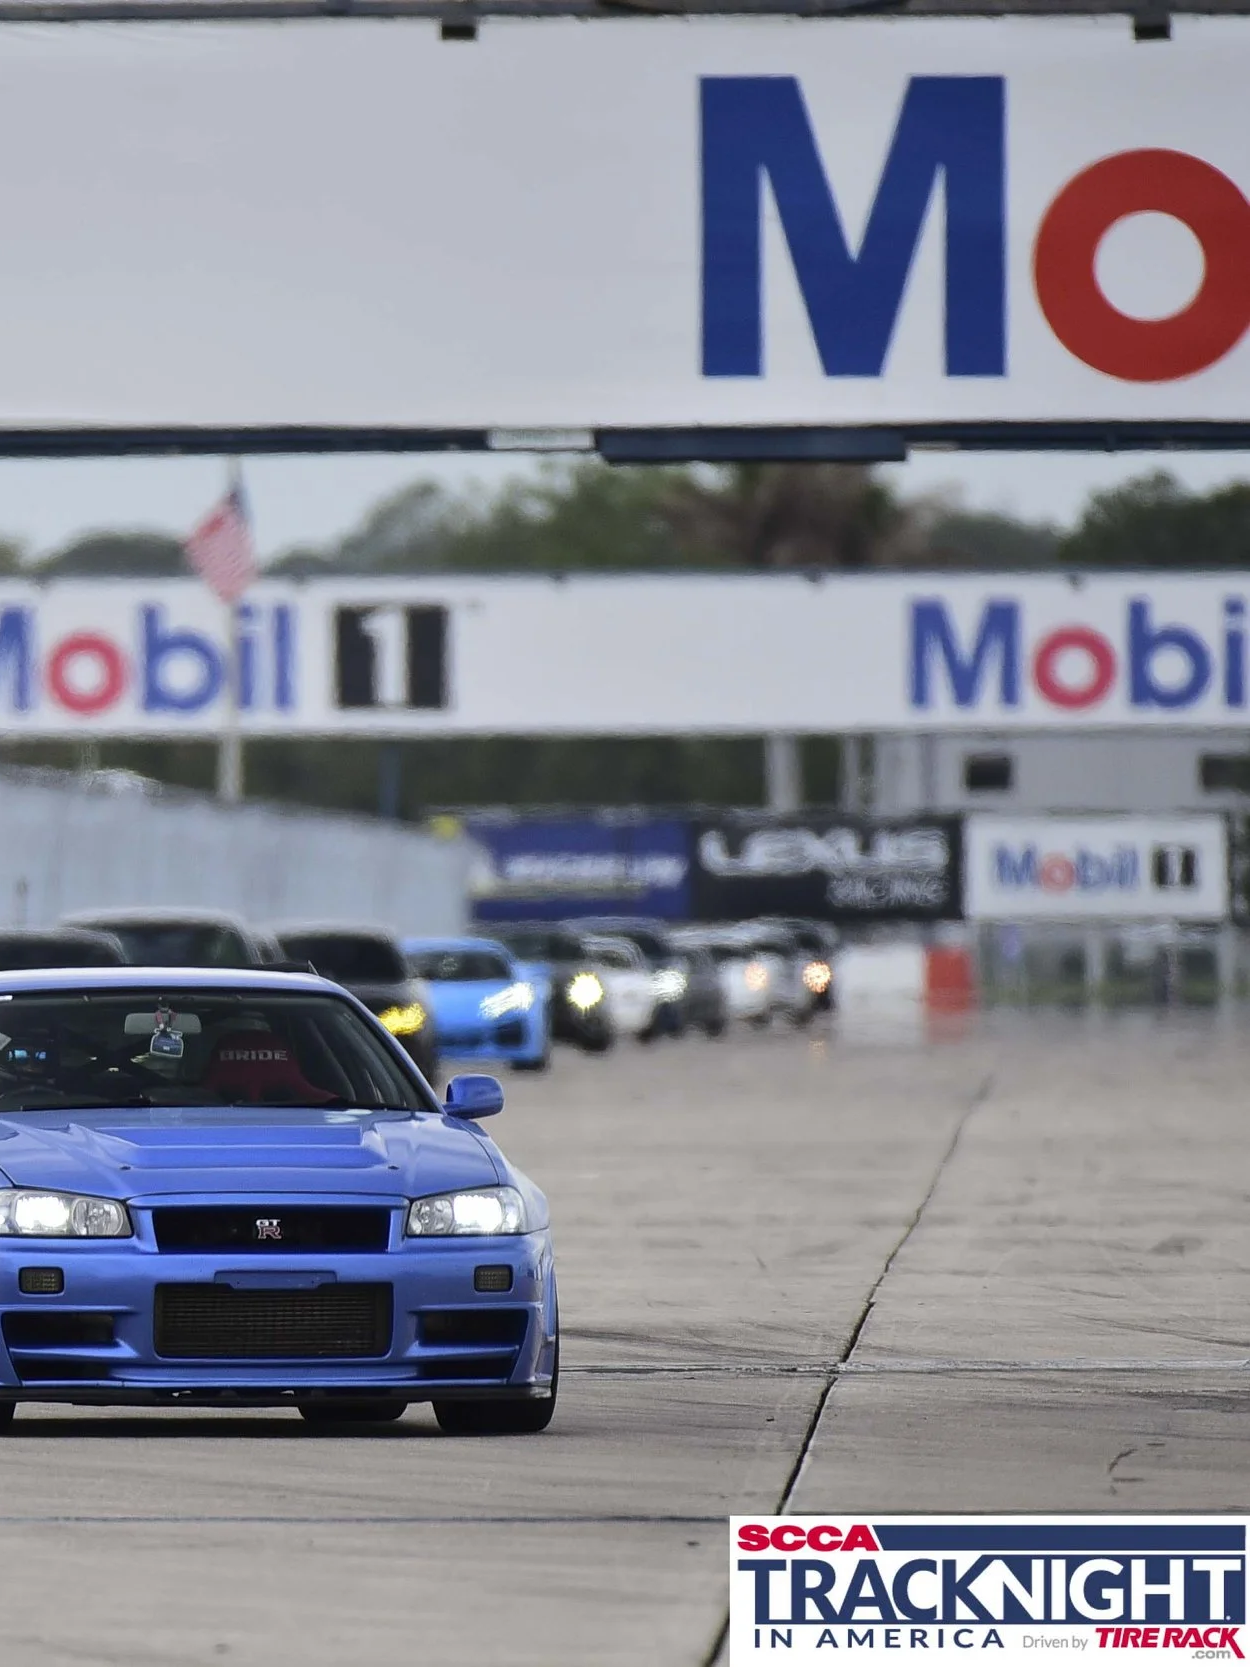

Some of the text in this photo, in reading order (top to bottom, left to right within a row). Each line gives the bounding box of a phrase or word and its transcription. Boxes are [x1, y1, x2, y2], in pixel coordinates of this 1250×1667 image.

[698, 74, 1250, 384] Mo
[910, 597, 1246, 709] Mobi
[994, 843, 1140, 892] Mobil
